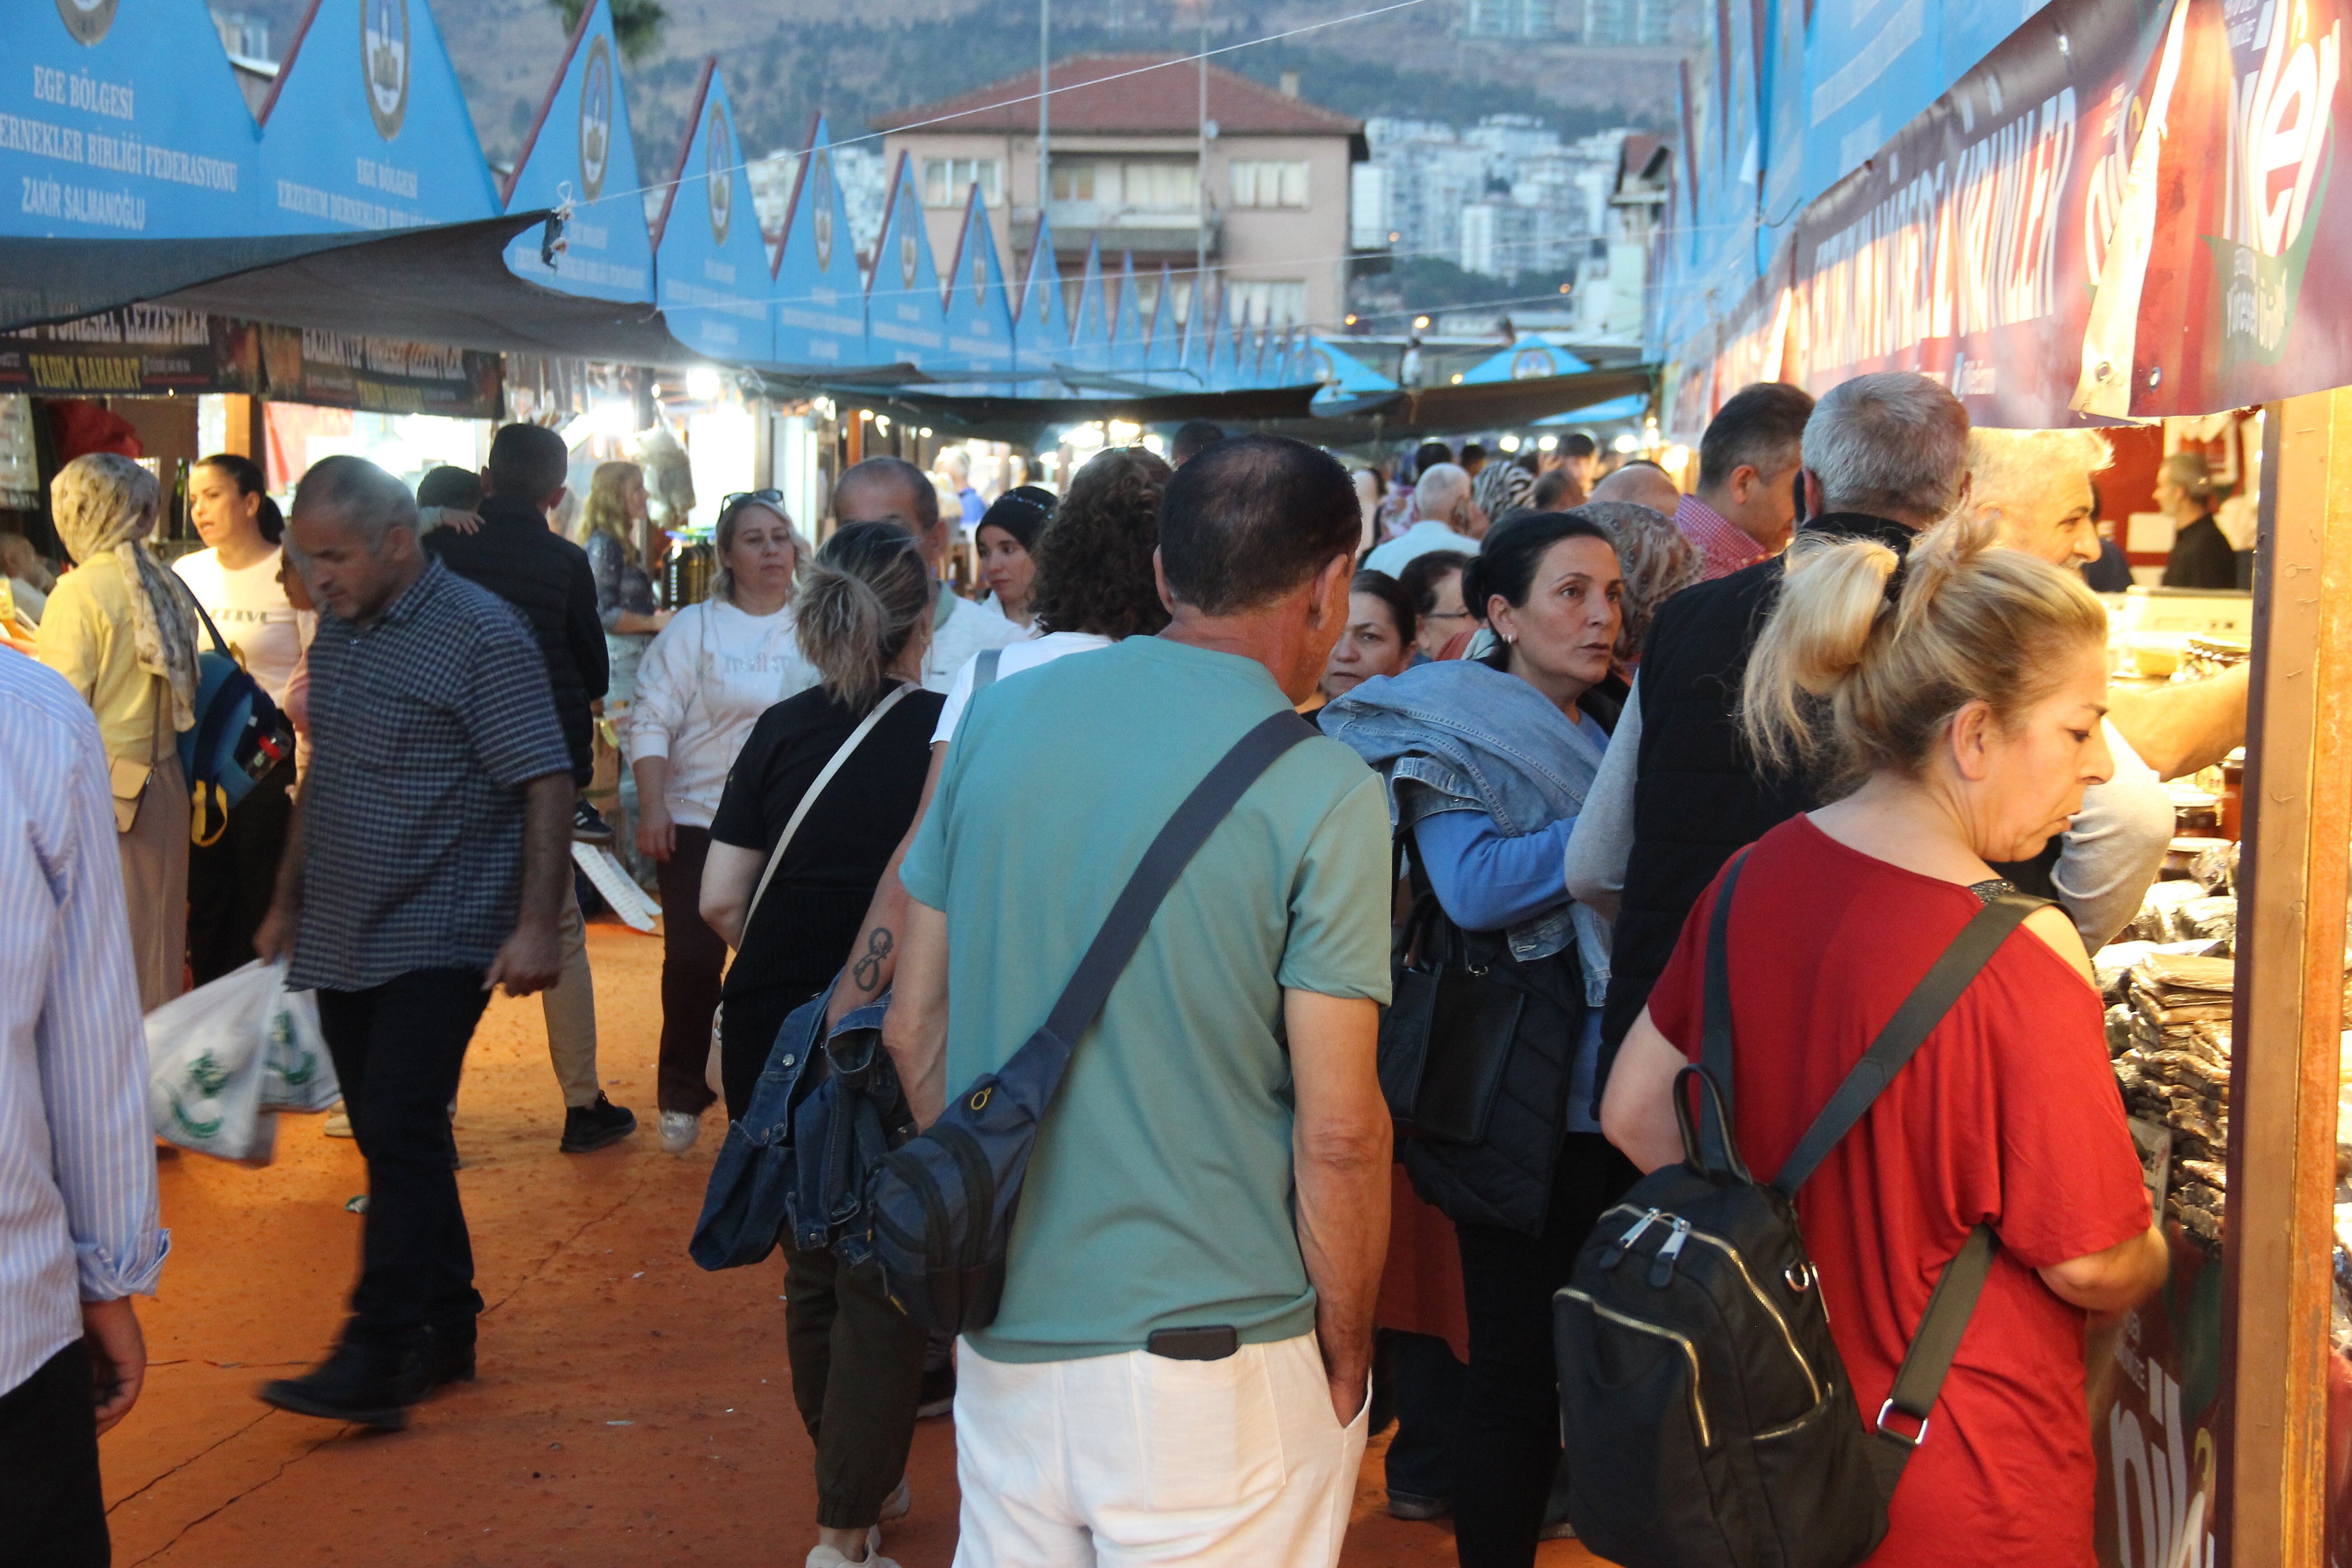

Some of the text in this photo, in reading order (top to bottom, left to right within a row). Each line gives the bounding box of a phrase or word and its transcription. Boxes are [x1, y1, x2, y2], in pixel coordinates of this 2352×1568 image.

[33, 65, 134, 121] EGE BÖLGESİ
[87, 126, 142, 175] BİRLİĞİ
[145, 145, 238, 192] FEDERASYONU
[21, 174, 61, 218] ZAKİR
